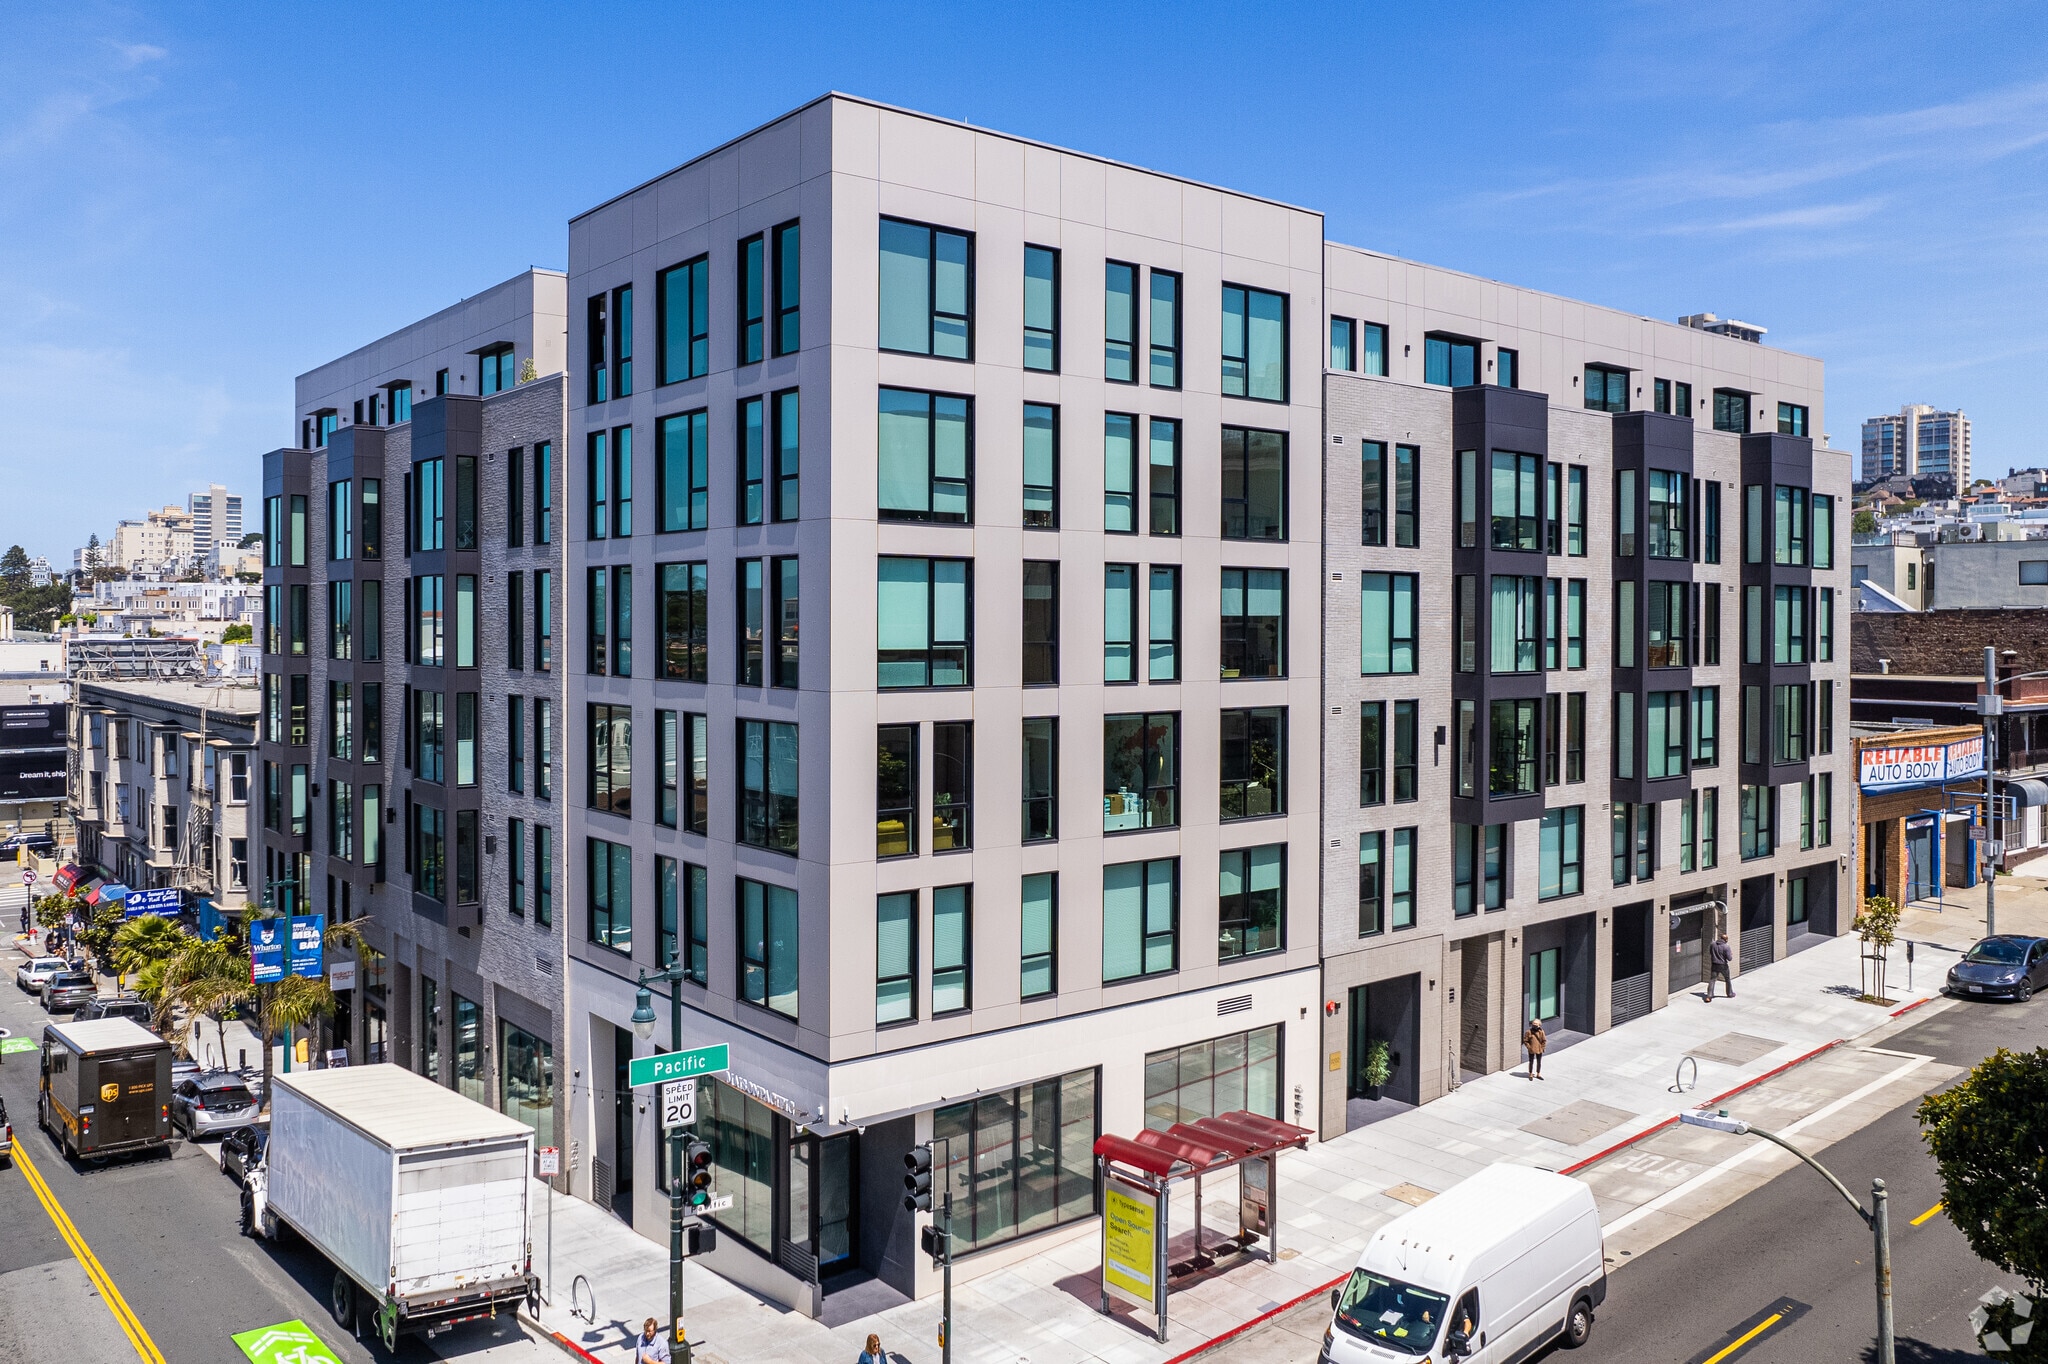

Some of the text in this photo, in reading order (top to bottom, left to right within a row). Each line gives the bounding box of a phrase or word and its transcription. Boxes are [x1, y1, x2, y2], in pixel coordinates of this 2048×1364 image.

[1863, 747, 1942, 766] RELIABLE
[1947, 738, 1982, 760] RELIABLE
[1869, 762, 1938, 781] AUTO BODY
[1948, 754, 1980, 775] AUTO BODY
[51, 770, 66, 778] ship
[292, 930, 320, 939] MBA
[253, 944, 282, 952] Wharton
[299, 941, 320, 950] BAY
[654, 1055, 706, 1077] Pacific
[103, 1088, 118, 1100] ups
[665, 1083, 693, 1095] SPEED
[668, 1093, 690, 1104] LIMIT
[667, 1103, 692, 1122] 20
[1611, 1153, 1699, 1181] STOP
[1109, 1222, 1133, 1238] Search.
[1110, 1212, 1151, 1235] Open Source
